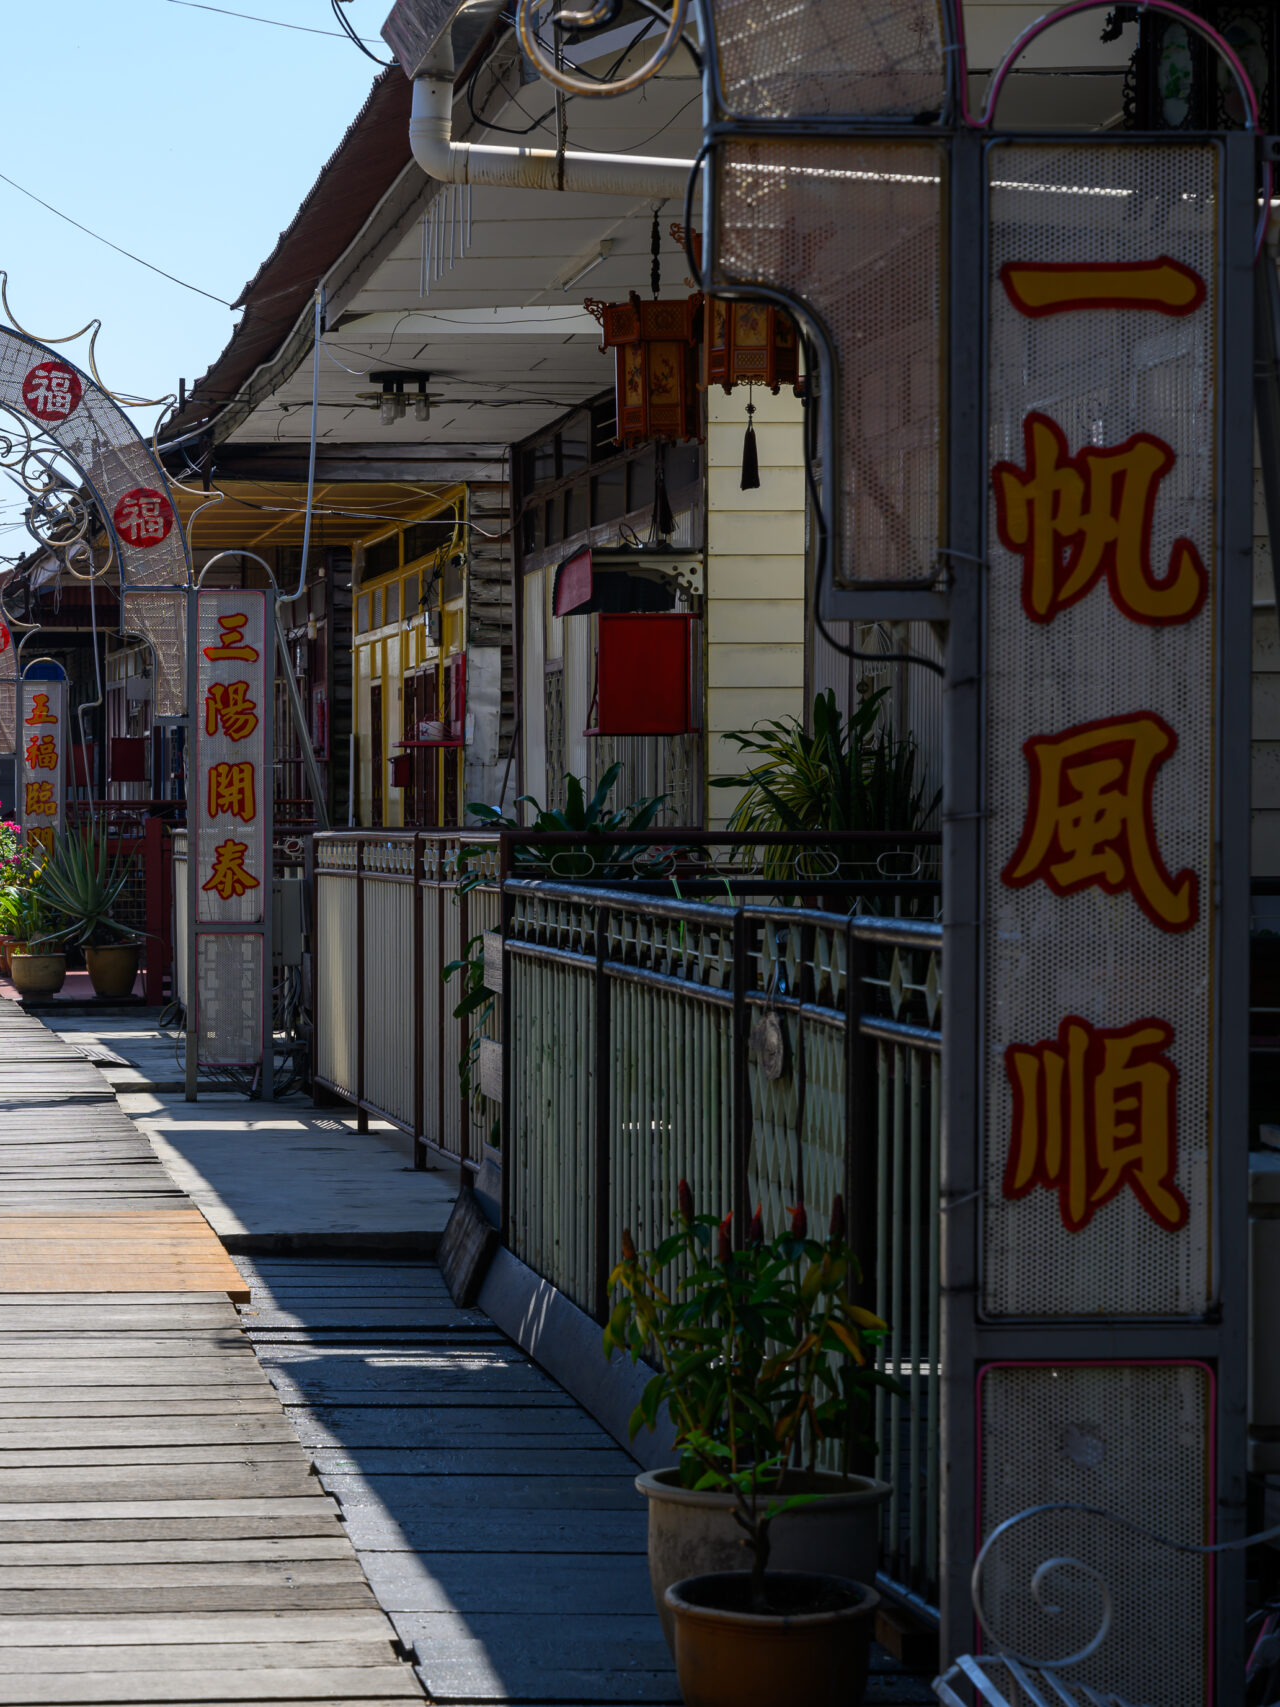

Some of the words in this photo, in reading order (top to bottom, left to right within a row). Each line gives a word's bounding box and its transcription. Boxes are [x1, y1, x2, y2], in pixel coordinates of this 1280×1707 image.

[25, 367, 74, 416] 福
[118, 495, 166, 542] 福
[25, 693, 59, 858] 五福臨門
[202, 613, 260, 900] 三陽開泰
[993, 255, 1208, 1232] 一帆風順
